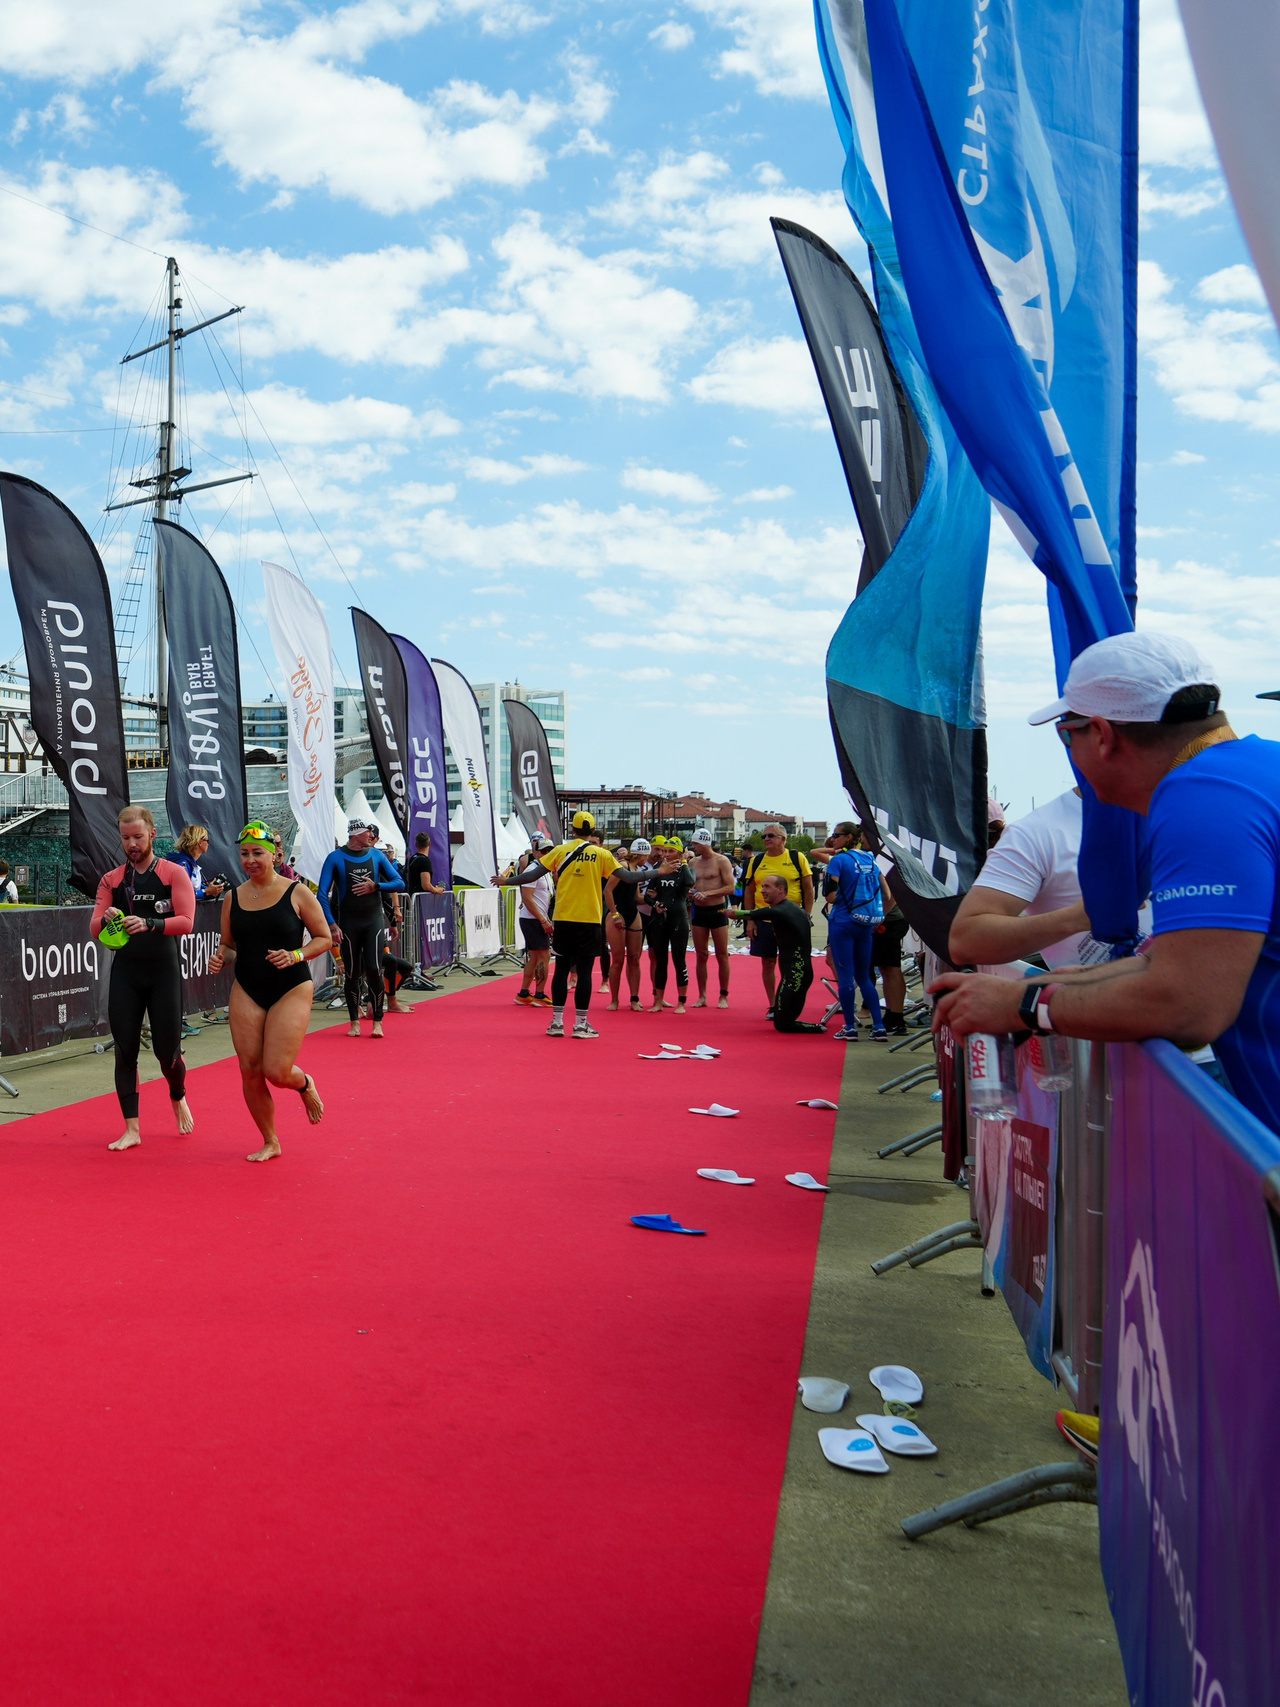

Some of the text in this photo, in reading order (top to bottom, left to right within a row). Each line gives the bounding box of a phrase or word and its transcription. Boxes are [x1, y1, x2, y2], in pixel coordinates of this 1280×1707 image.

[565, 851, 597, 863] ДЬЯ
[661, 879, 674, 887] TYR
[1155, 884, 1238, 903] самолет
[21, 938, 99, 982] bioniq
